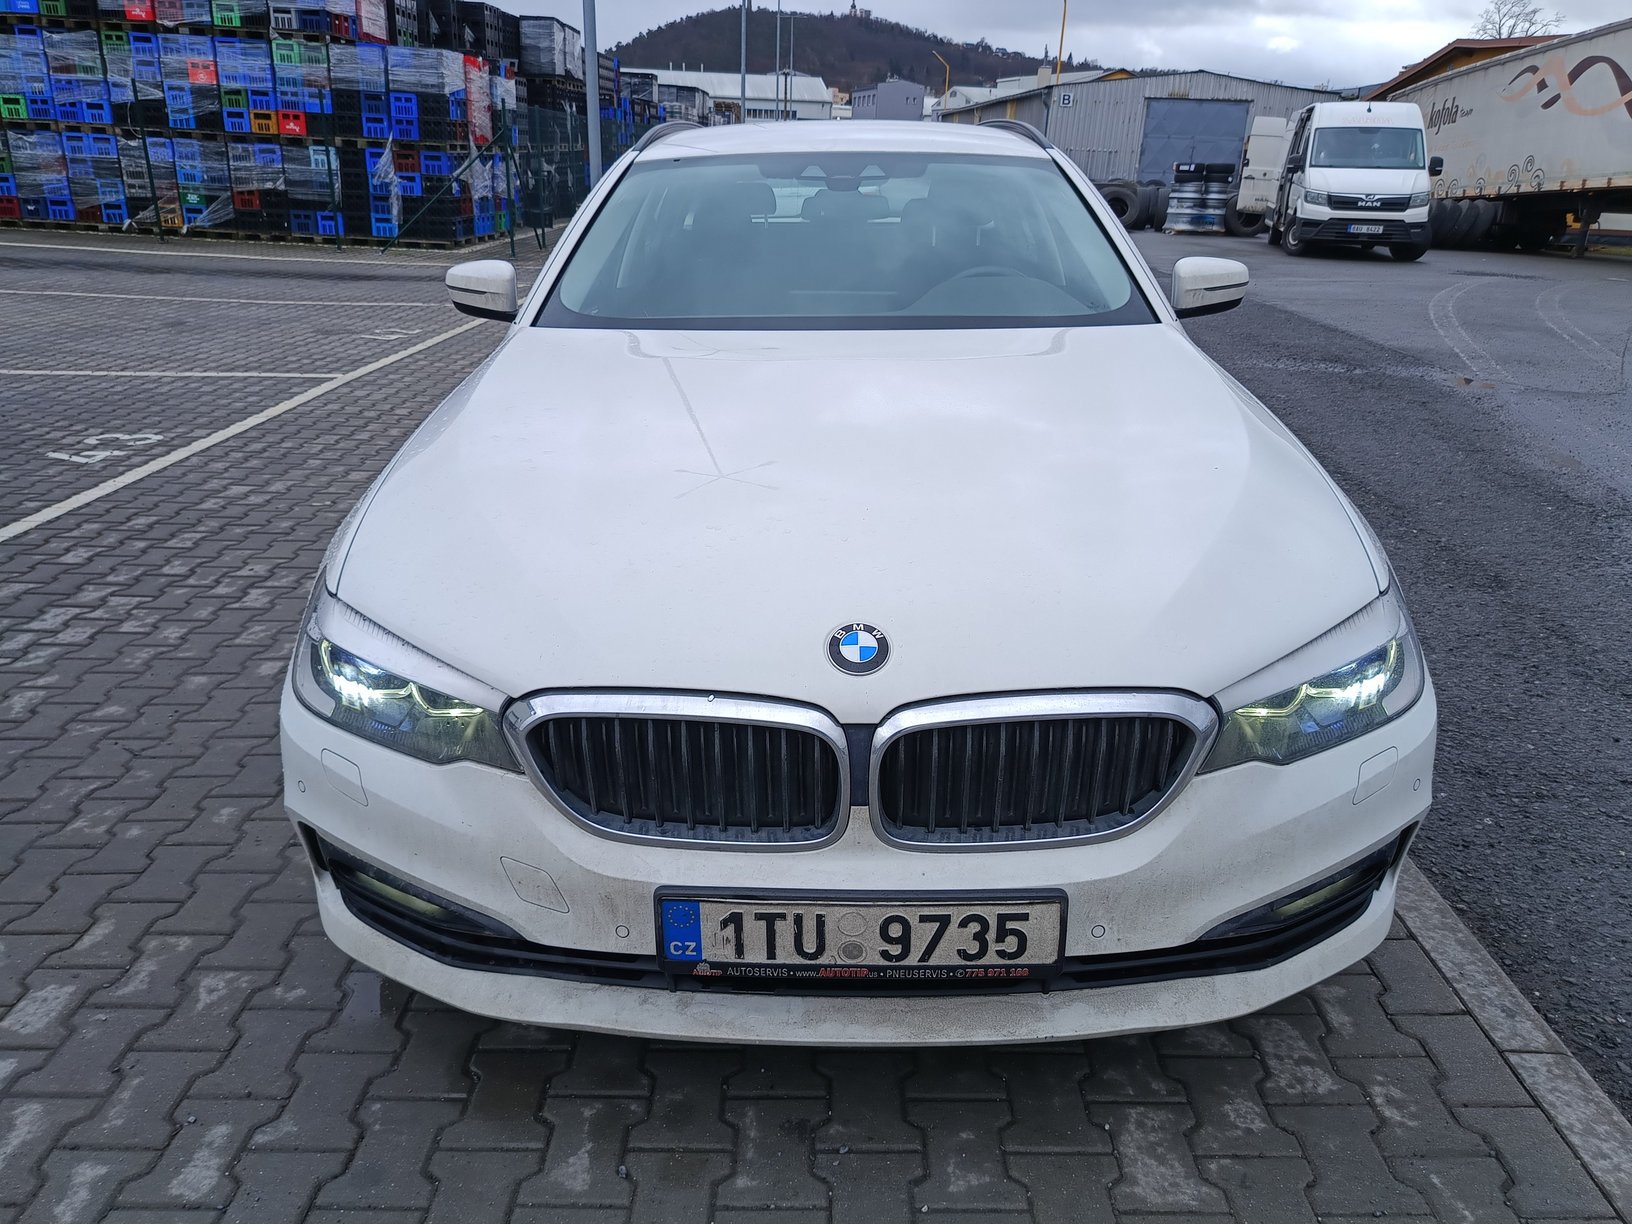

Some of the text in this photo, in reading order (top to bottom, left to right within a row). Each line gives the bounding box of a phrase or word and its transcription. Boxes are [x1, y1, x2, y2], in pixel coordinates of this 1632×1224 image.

[1062, 94, 1071, 105] B
[1427, 96, 1459, 136] kofola
[834, 623, 884, 639] BMW
[719, 911, 1030, 963] 1TU 9735
[669, 941, 697, 956] CZ
[727, 967, 788, 977] AUTOSERVIS
[886, 969, 947, 978] PNEUSERVIS
